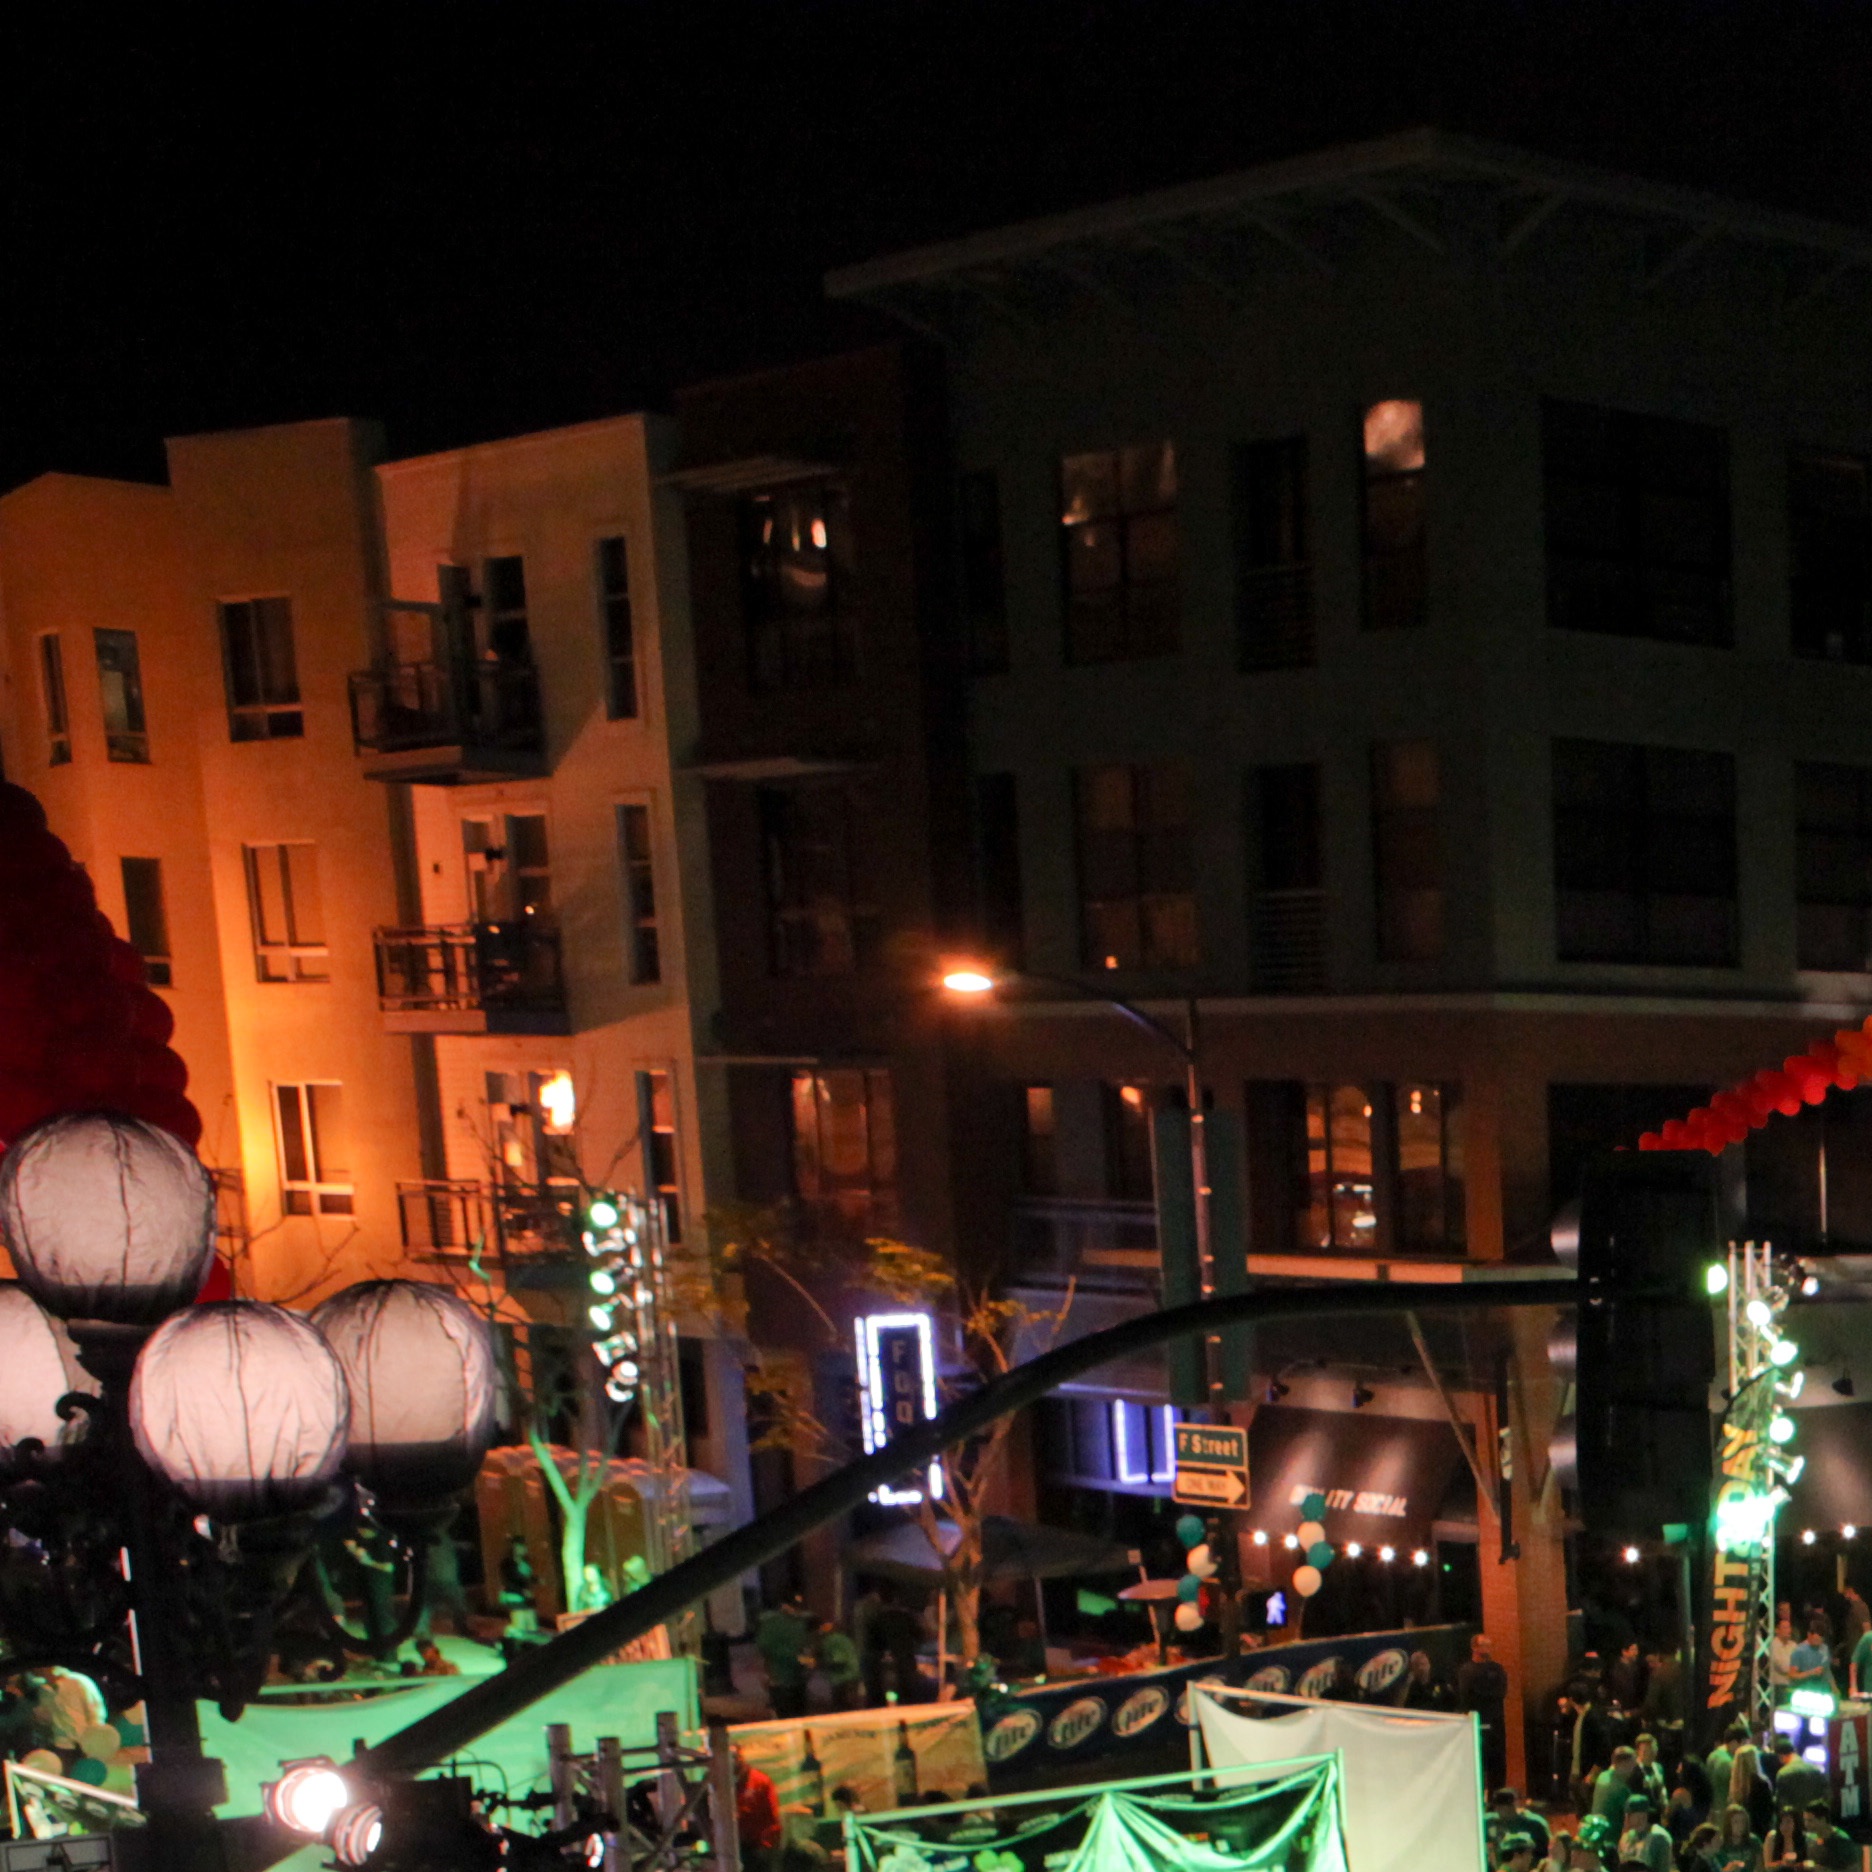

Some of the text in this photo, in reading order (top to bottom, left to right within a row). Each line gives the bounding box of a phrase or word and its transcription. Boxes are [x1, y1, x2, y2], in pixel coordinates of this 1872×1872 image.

[1178, 1432, 1239, 1457] F Street
[1707, 1552, 1749, 1710] NIGHT
[1839, 1720, 1860, 1818] ATM
